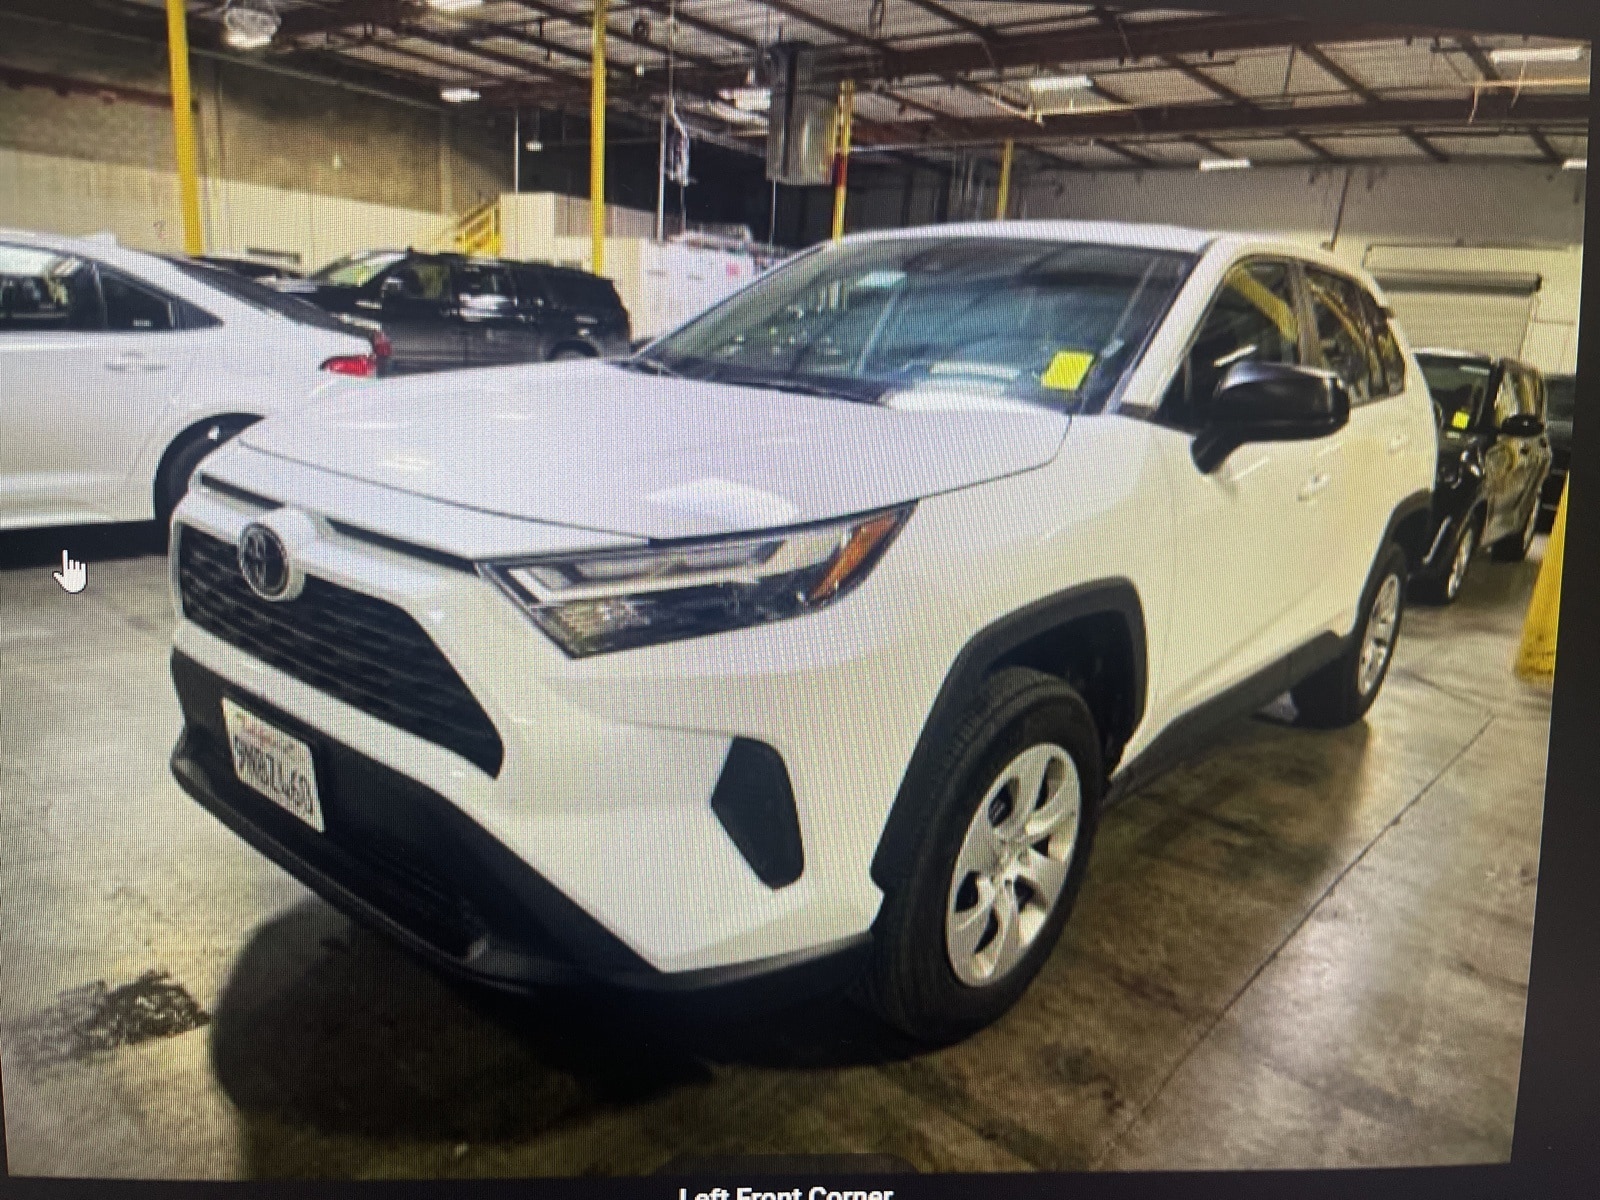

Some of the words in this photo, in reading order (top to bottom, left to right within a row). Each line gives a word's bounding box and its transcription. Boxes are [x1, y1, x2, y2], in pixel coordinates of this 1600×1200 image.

[679, 1187, 730, 1200] Left
[736, 1187, 803, 1200] Front
[808, 1186, 894, 1200] Corner
